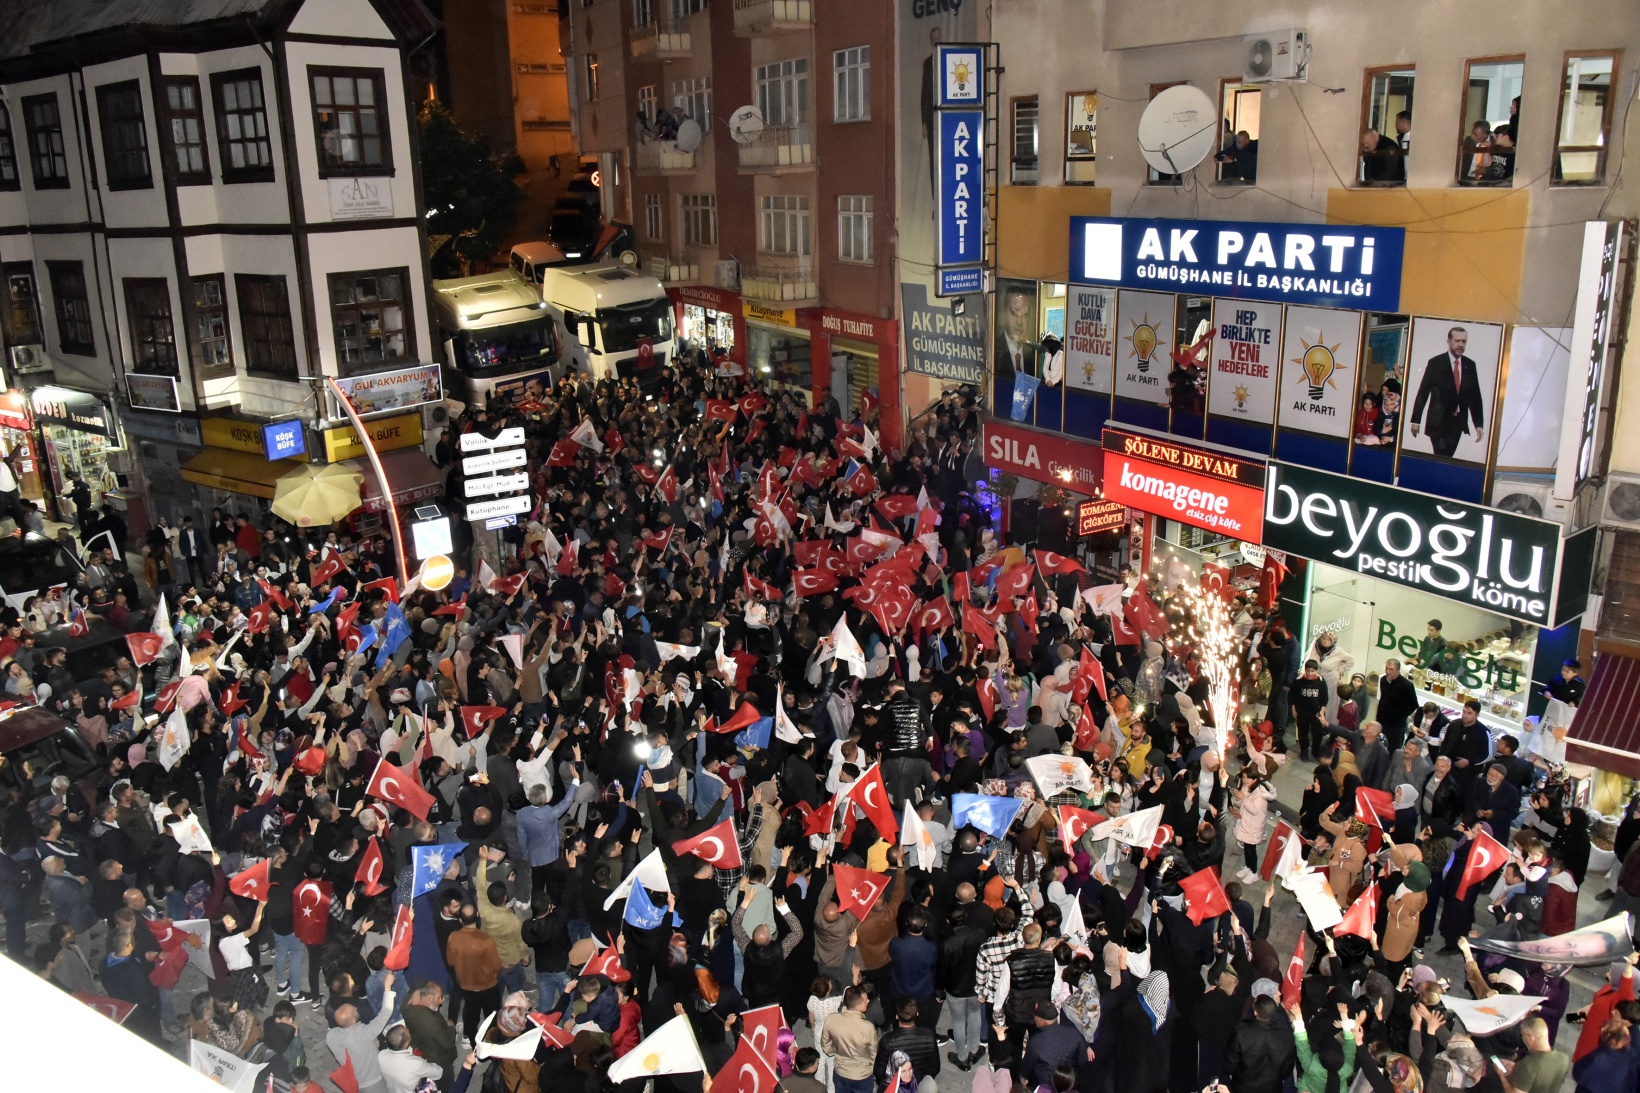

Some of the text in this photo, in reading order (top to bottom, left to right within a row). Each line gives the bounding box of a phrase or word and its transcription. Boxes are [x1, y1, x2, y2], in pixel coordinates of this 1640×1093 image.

[1136, 227, 1200, 263] AK
[945, 273, 978, 282] GÜMÜŞHANE
[951, 281, 978, 289] BAŞKANLIĞI
[1136, 264, 1371, 297] GÜMÜŞHANE İL BAŞKANLIĞI
[911, 310, 933, 333] AK
[1080, 307, 1102, 322] DAVA
[1235, 309, 1257, 326] HEP
[822, 314, 874, 337] DOĞUŞ TUHAFİYE
[912, 335, 984, 362] GÜMÜŞHANE
[914, 355, 983, 383] İL BAŞKANLIĞ
[1126, 373, 1137, 383] AK
[1217, 358, 1269, 379] HEDEFLERE
[354, 371, 428, 391] GÜL AKVARYUM
[1293, 401, 1307, 412] AK
[277, 438, 295, 450] BÜFE
[377, 426, 401, 442] BÜFE
[465, 438, 488, 446] Valilik
[989, 435, 1041, 470] SILA
[1124, 436, 1238, 479] ŞÖLENE DEVAM
[1120, 462, 1229, 515] komagene
[1083, 512, 1123, 531] ÇİĞKÖFTE
[1186, 509, 1241, 531] etsiz çiğ köfte
[1265, 465, 1544, 593] beyoğlu
[1358, 552, 1546, 618] pestil köme
[1375, 617, 1520, 692] Beyoğlu
[424, 880, 437, 891] AK
[636, 916, 648, 927] AK
